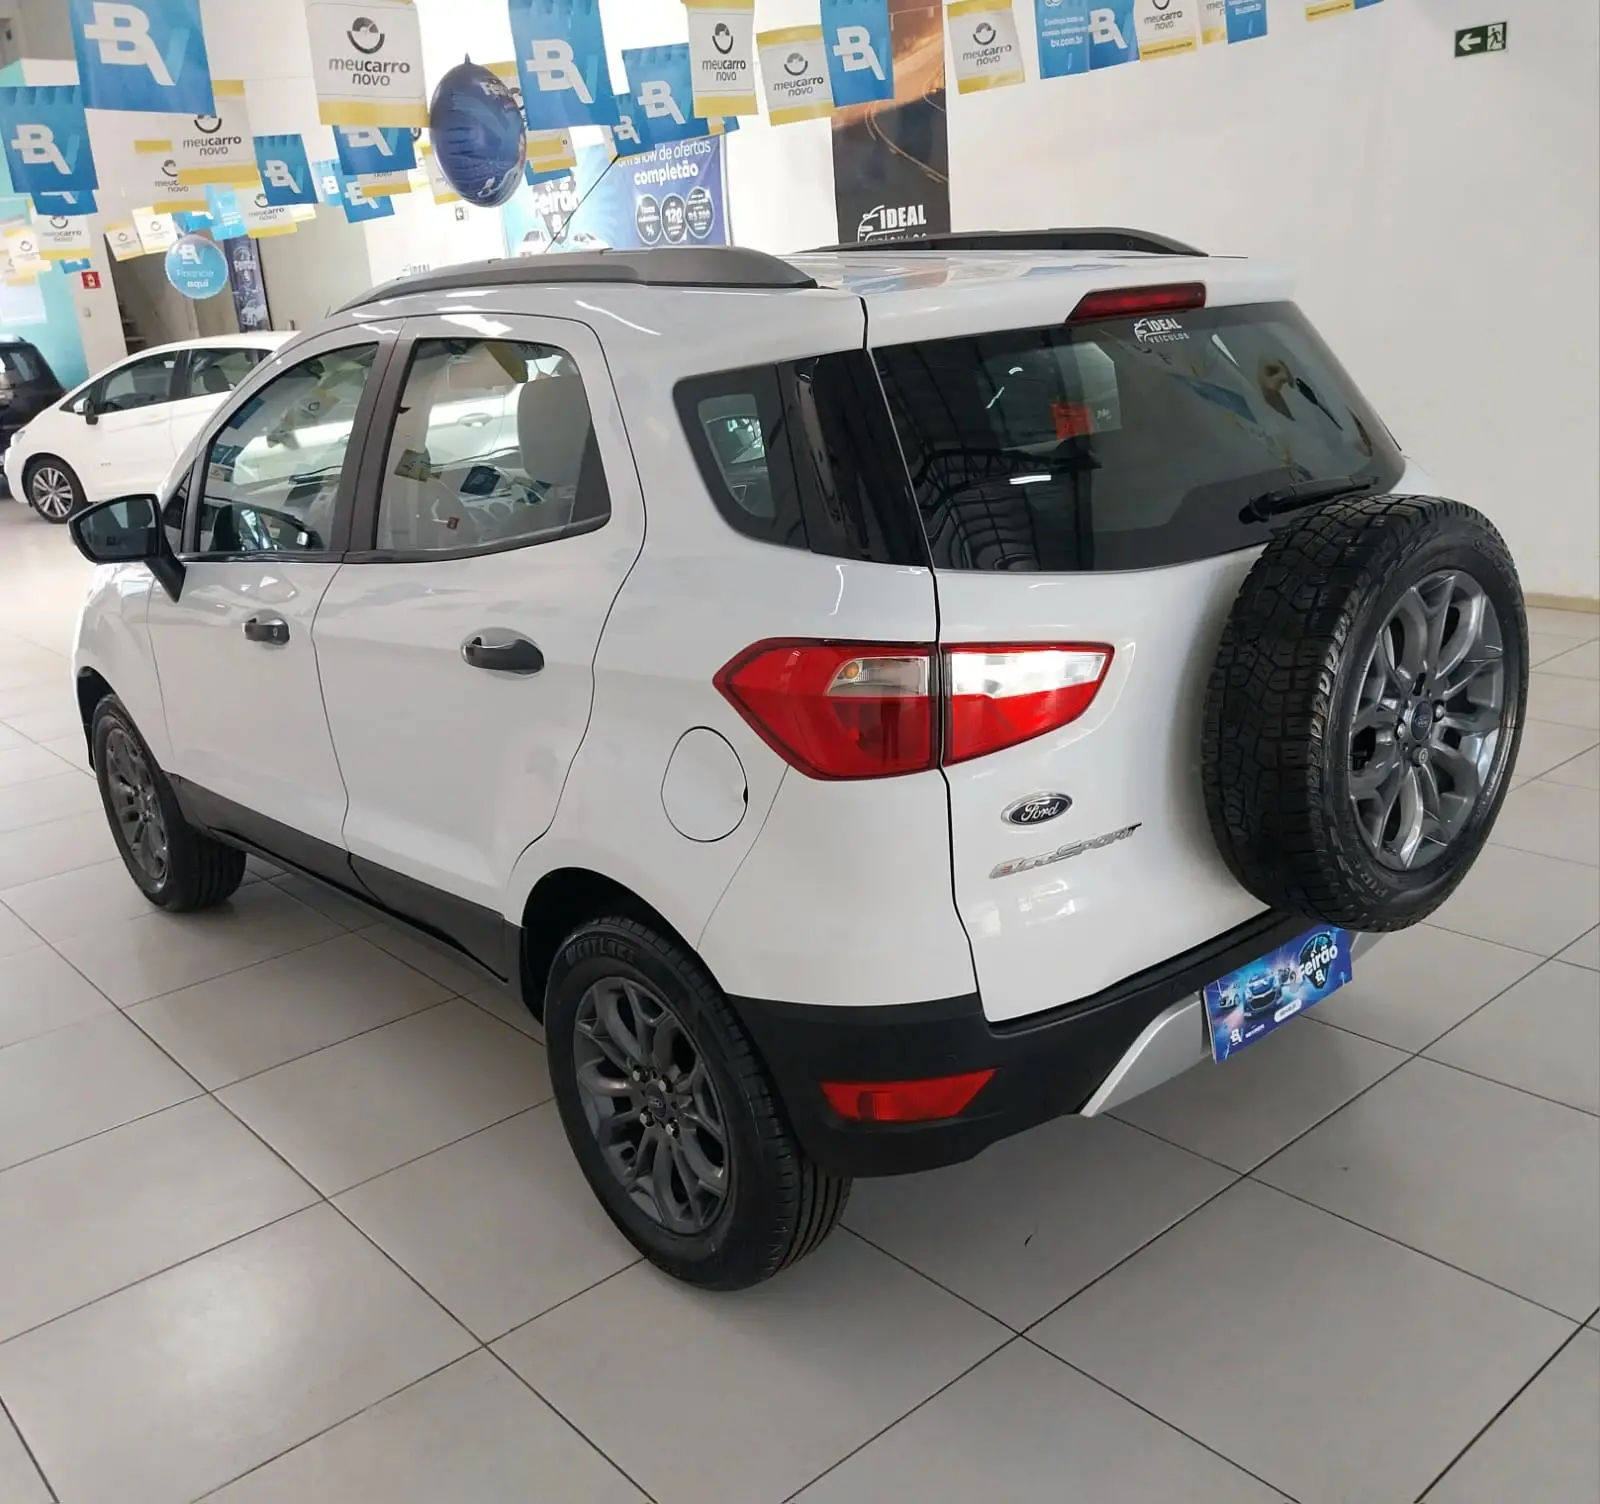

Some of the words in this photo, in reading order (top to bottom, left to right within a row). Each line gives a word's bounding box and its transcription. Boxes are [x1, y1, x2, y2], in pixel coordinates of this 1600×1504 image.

[1144, 11, 1183, 25] meucarro
[1154, 21, 1175, 31] novo
[962, 43, 1012, 62] meucarro
[975, 53, 1001, 66] novo
[328, 56, 410, 74] meucarro
[702, 58, 747, 71] meucarro
[351, 72, 391, 87] novo
[716, 70, 737, 82] novo
[773, 76, 824, 91] meucarro
[788, 86, 814, 97] novo
[182, 135, 242, 149] meucarro
[199, 145, 229, 156] novo
[659, 145, 672, 161] de
[673, 140, 711, 159] ofertas
[634, 160, 699, 186] completão
[167, 184, 189, 193] novo
[880, 204, 927, 230] IDEAL
[187, 280, 209, 289] aqui
[1146, 318, 1182, 332] IDEAL
[1020, 801, 1061, 822] Ford
[1299, 944, 1339, 982] Feirão
